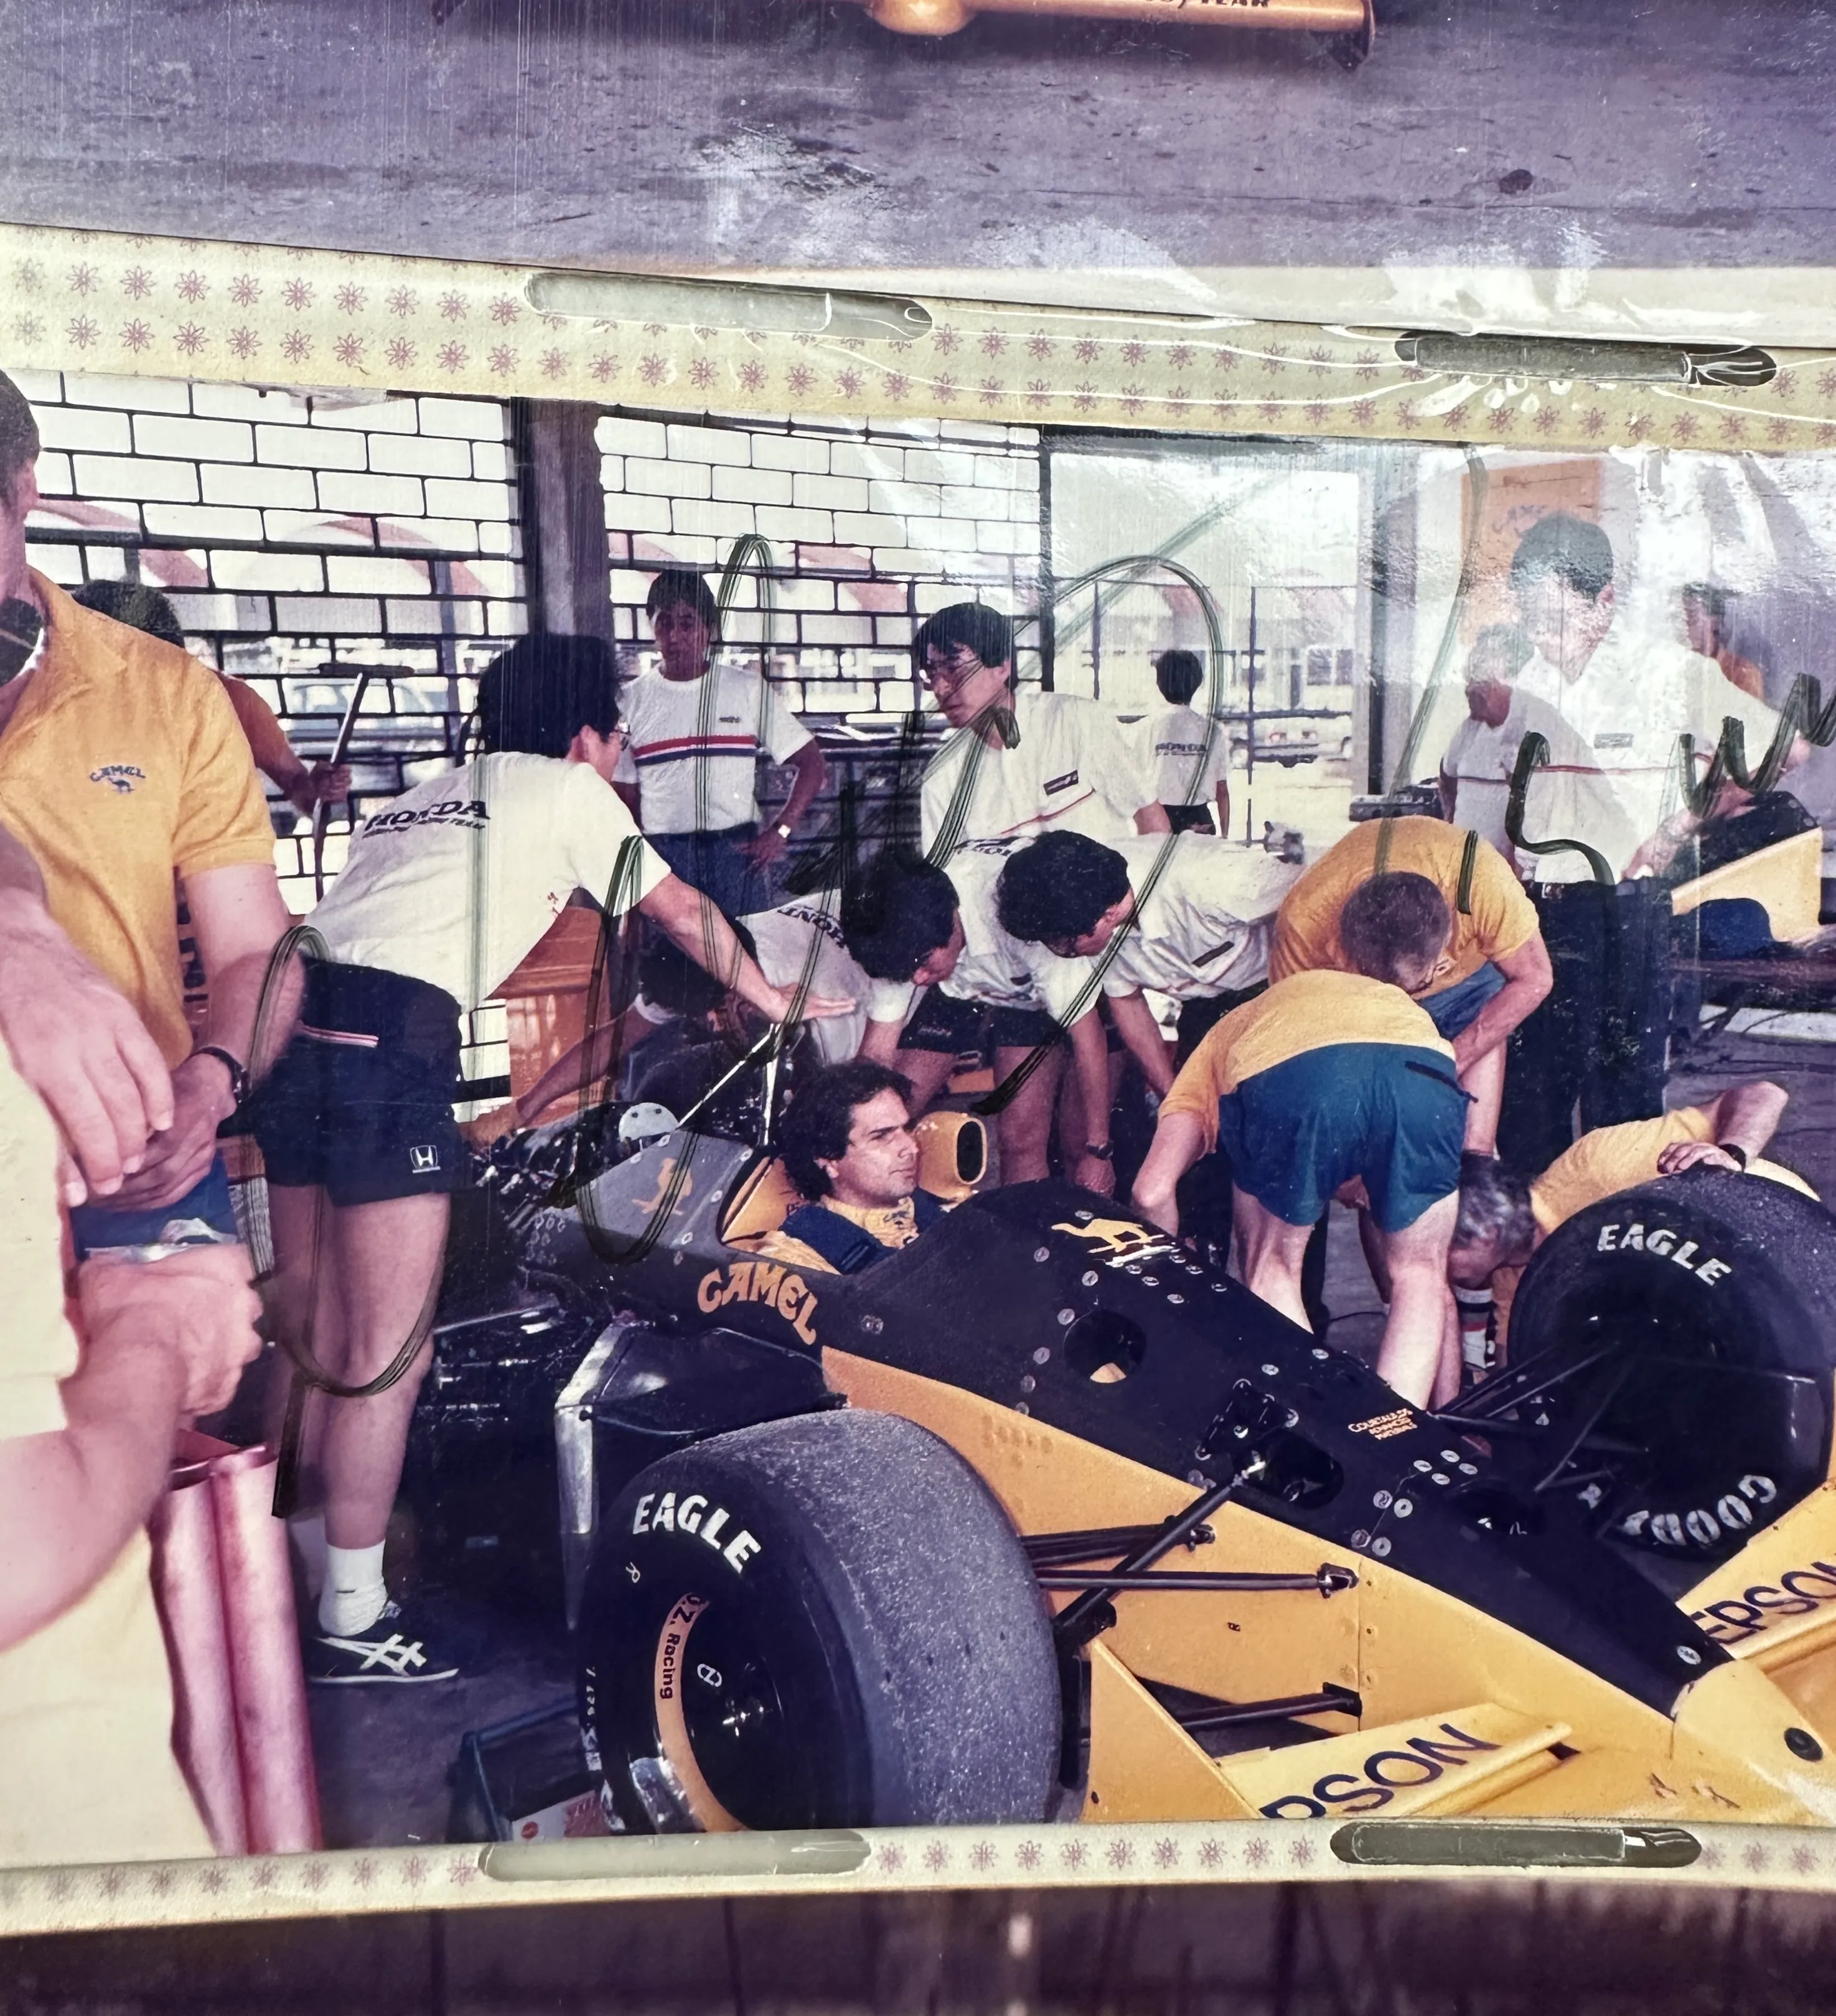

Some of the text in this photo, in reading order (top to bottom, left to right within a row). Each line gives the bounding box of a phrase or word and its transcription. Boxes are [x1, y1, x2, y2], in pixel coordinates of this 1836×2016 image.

[1597, 1223, 1732, 1286] EAGLE
[697, 1262, 818, 1345] CAMEL
[632, 1492, 761, 1574] EAGLE
[660, 1633, 681, 1699] Racing
